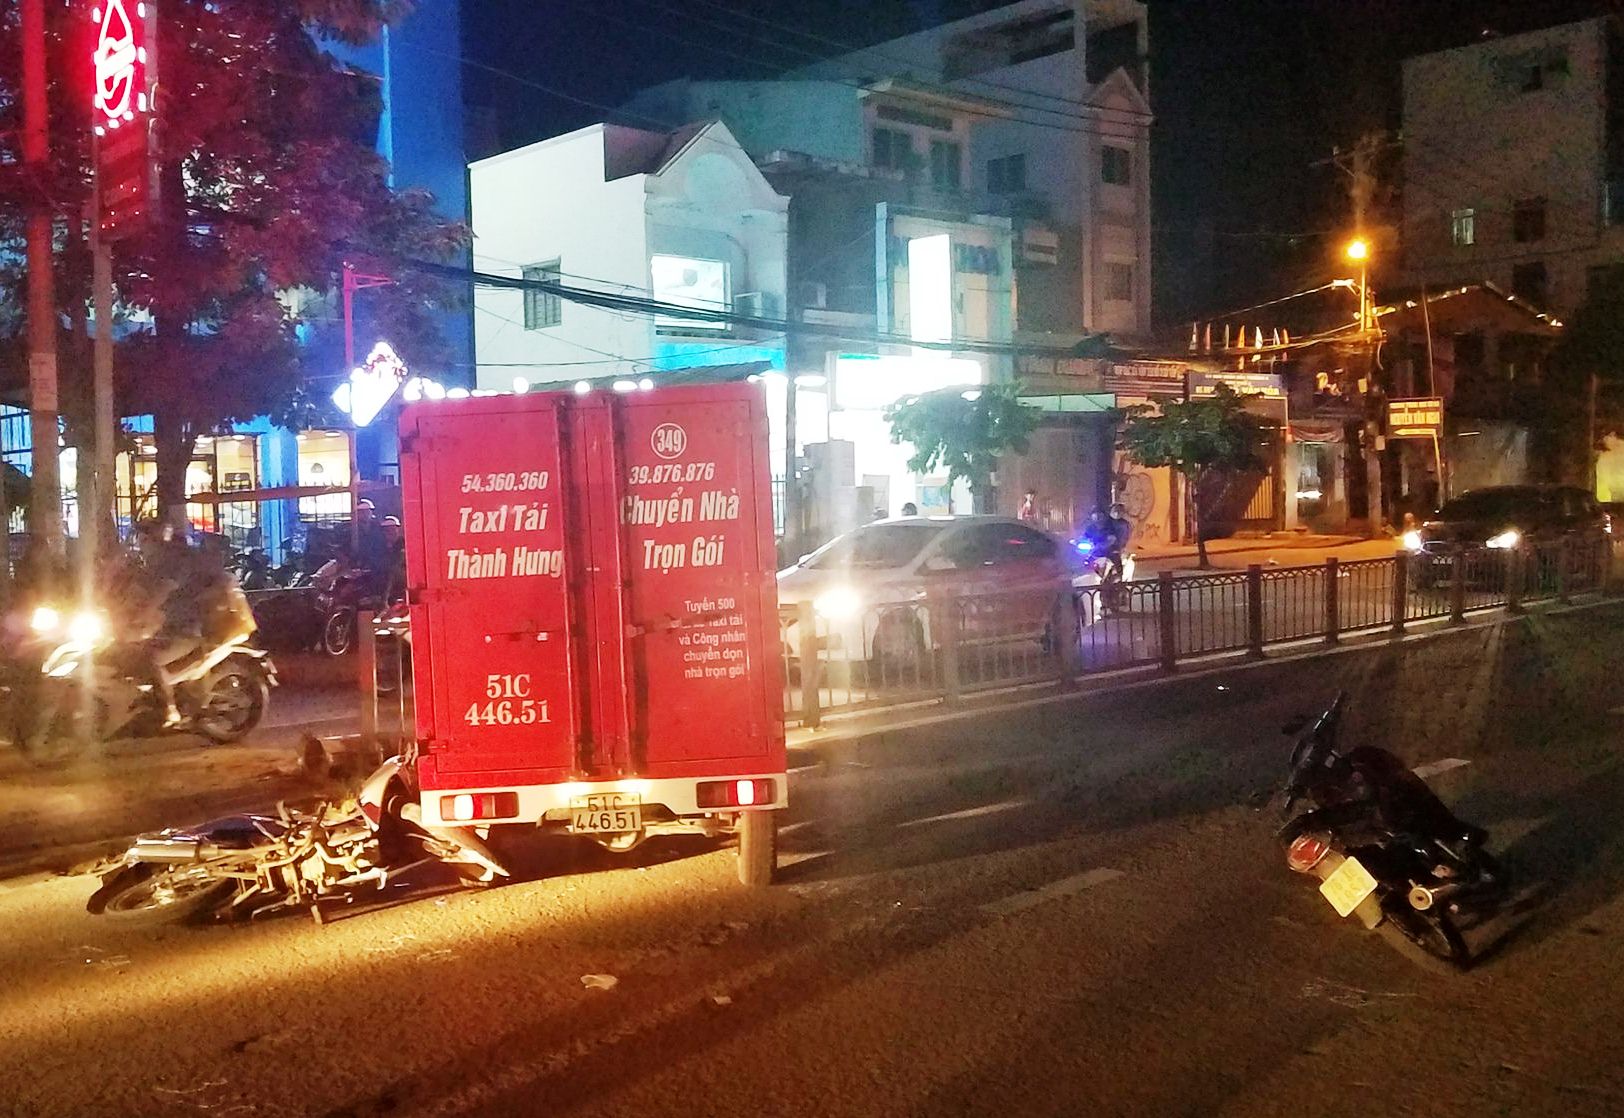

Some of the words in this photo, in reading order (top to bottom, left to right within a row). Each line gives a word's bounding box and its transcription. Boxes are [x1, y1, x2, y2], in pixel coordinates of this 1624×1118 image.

[657, 428, 682, 452] 349
[461, 471, 548, 493] 54.360.360
[629, 462, 716, 485] 39.876.876
[512, 502, 548, 531] Tải
[620, 486, 694, 528] Chuyển
[700, 488, 740, 521] Nhà
[447, 548, 507, 580] Thành
[512, 546, 563, 578] Hưng
[643, 539, 686, 574] Trọn
[692, 535, 725, 567] Gói
[684, 596, 716, 614] Tuyển
[717, 598, 736, 610] 500
[679, 633, 691, 645] và
[692, 632, 719, 646] Công
[721, 630, 746, 642] nhân
[723, 647, 743, 661] dọn
[684, 666, 703, 679] nhà
[705, 666, 727, 679] trọn
[486, 673, 530, 698] 51C
[464, 699, 551, 726] 446.51
[588, 796, 622, 812] 51C
[576, 811, 636, 830] 446.51
